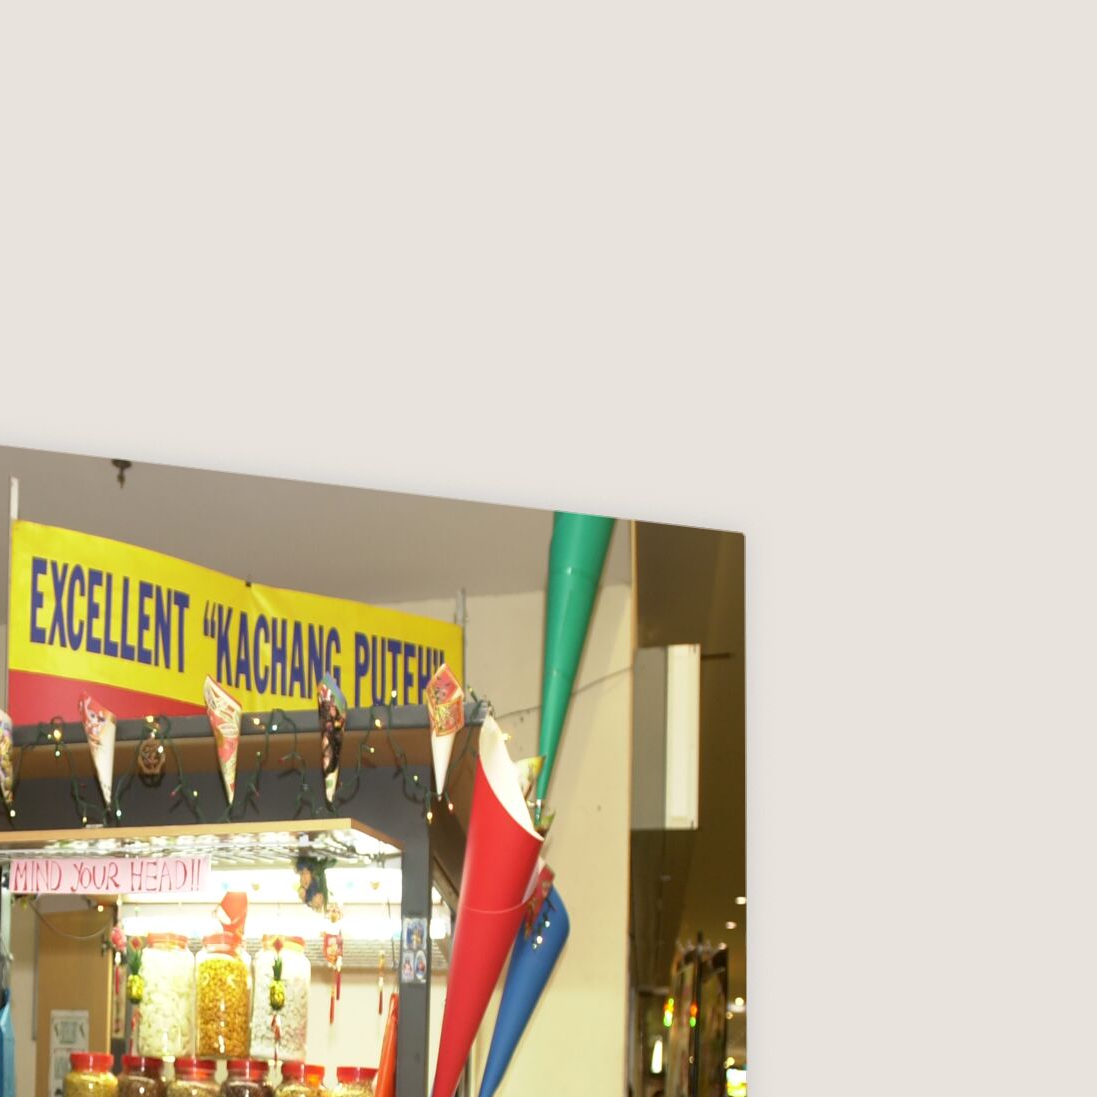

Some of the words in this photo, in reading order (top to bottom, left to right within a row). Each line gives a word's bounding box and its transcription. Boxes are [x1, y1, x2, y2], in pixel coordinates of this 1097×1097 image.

[30, 556, 190, 673] EXCELLENT
[13, 859, 63, 892] MIND
[70, 861, 120, 893] YOUR
[130, 858, 202, 892] HEAD!!
